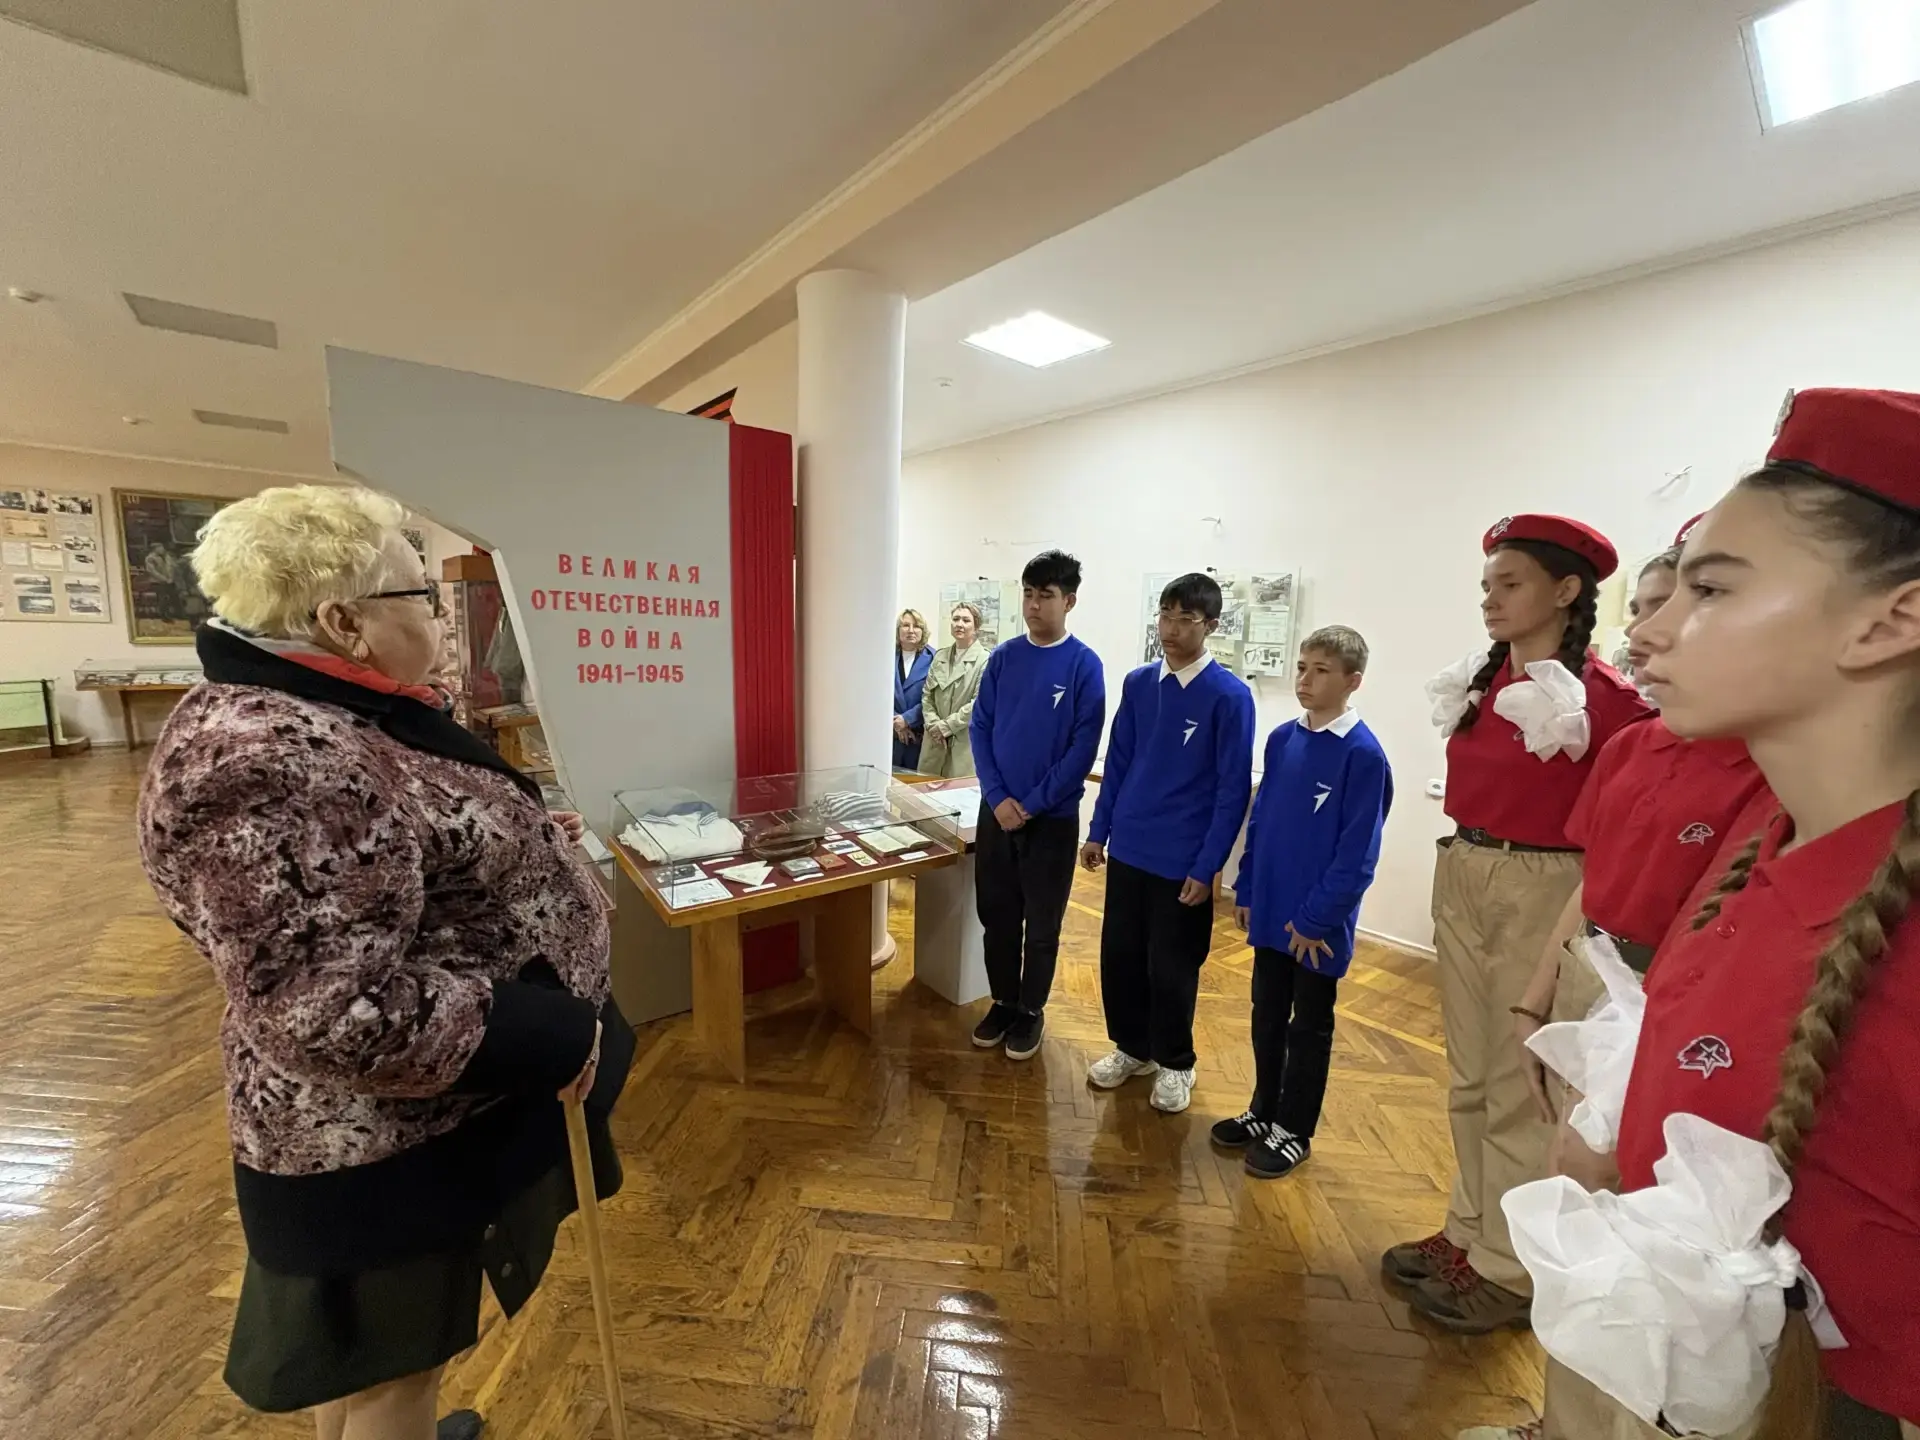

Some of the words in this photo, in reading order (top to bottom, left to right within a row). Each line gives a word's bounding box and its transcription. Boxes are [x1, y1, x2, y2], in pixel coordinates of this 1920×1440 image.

[558, 553, 700, 584] ВЕЛИКАЯ
[531, 589, 720, 618] ОТЕЧЕСТВЕННАЯ
[578, 626, 682, 650] ВОЙНА
